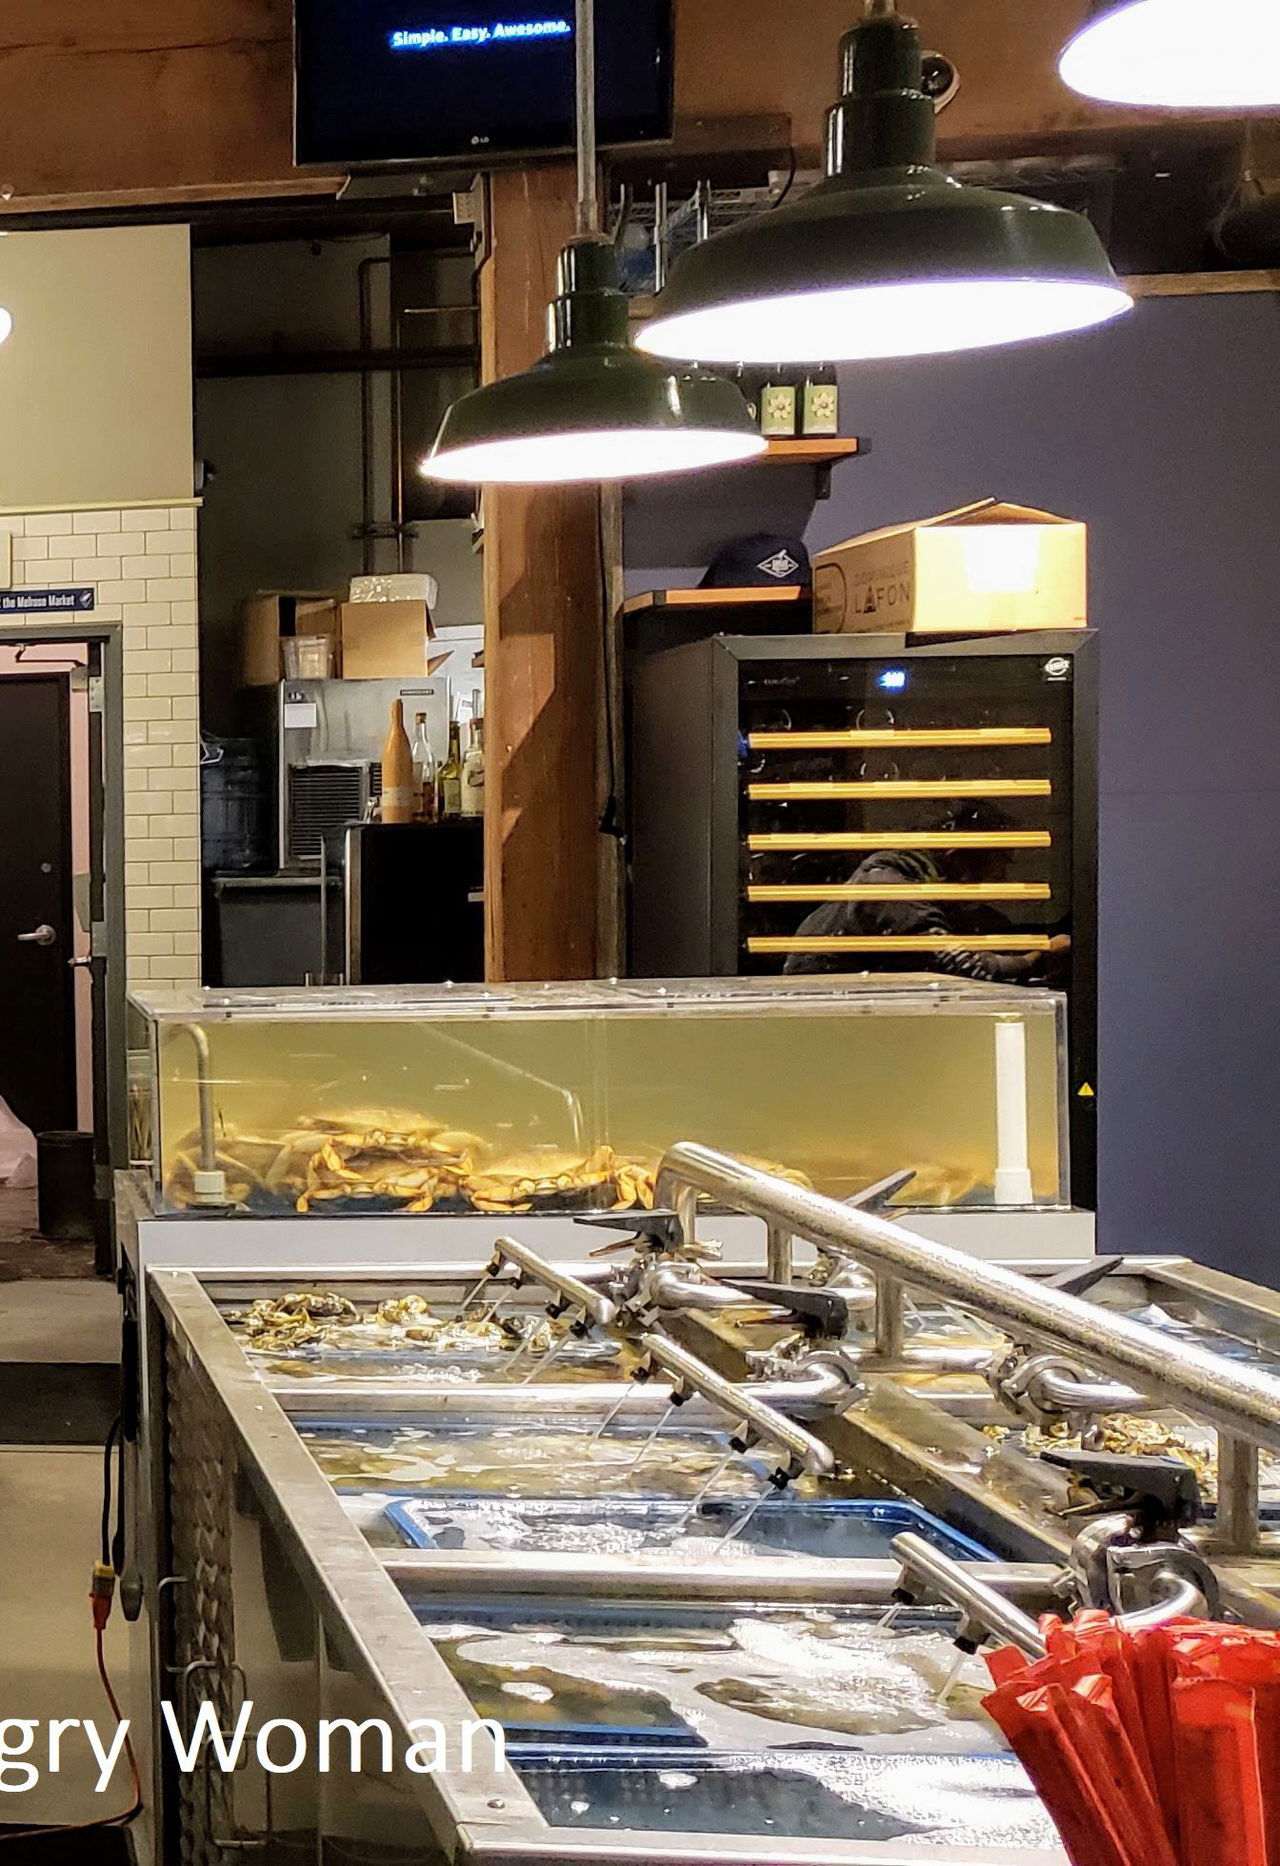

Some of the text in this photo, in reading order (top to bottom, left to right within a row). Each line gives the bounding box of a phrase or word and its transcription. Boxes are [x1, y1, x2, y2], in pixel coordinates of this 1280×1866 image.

[393, 20, 571, 46] Simple. Easy. Awesome.
[3, 596, 16, 608] the
[48, 594, 75, 606] Market
[854, 582, 911, 615] LAFON
